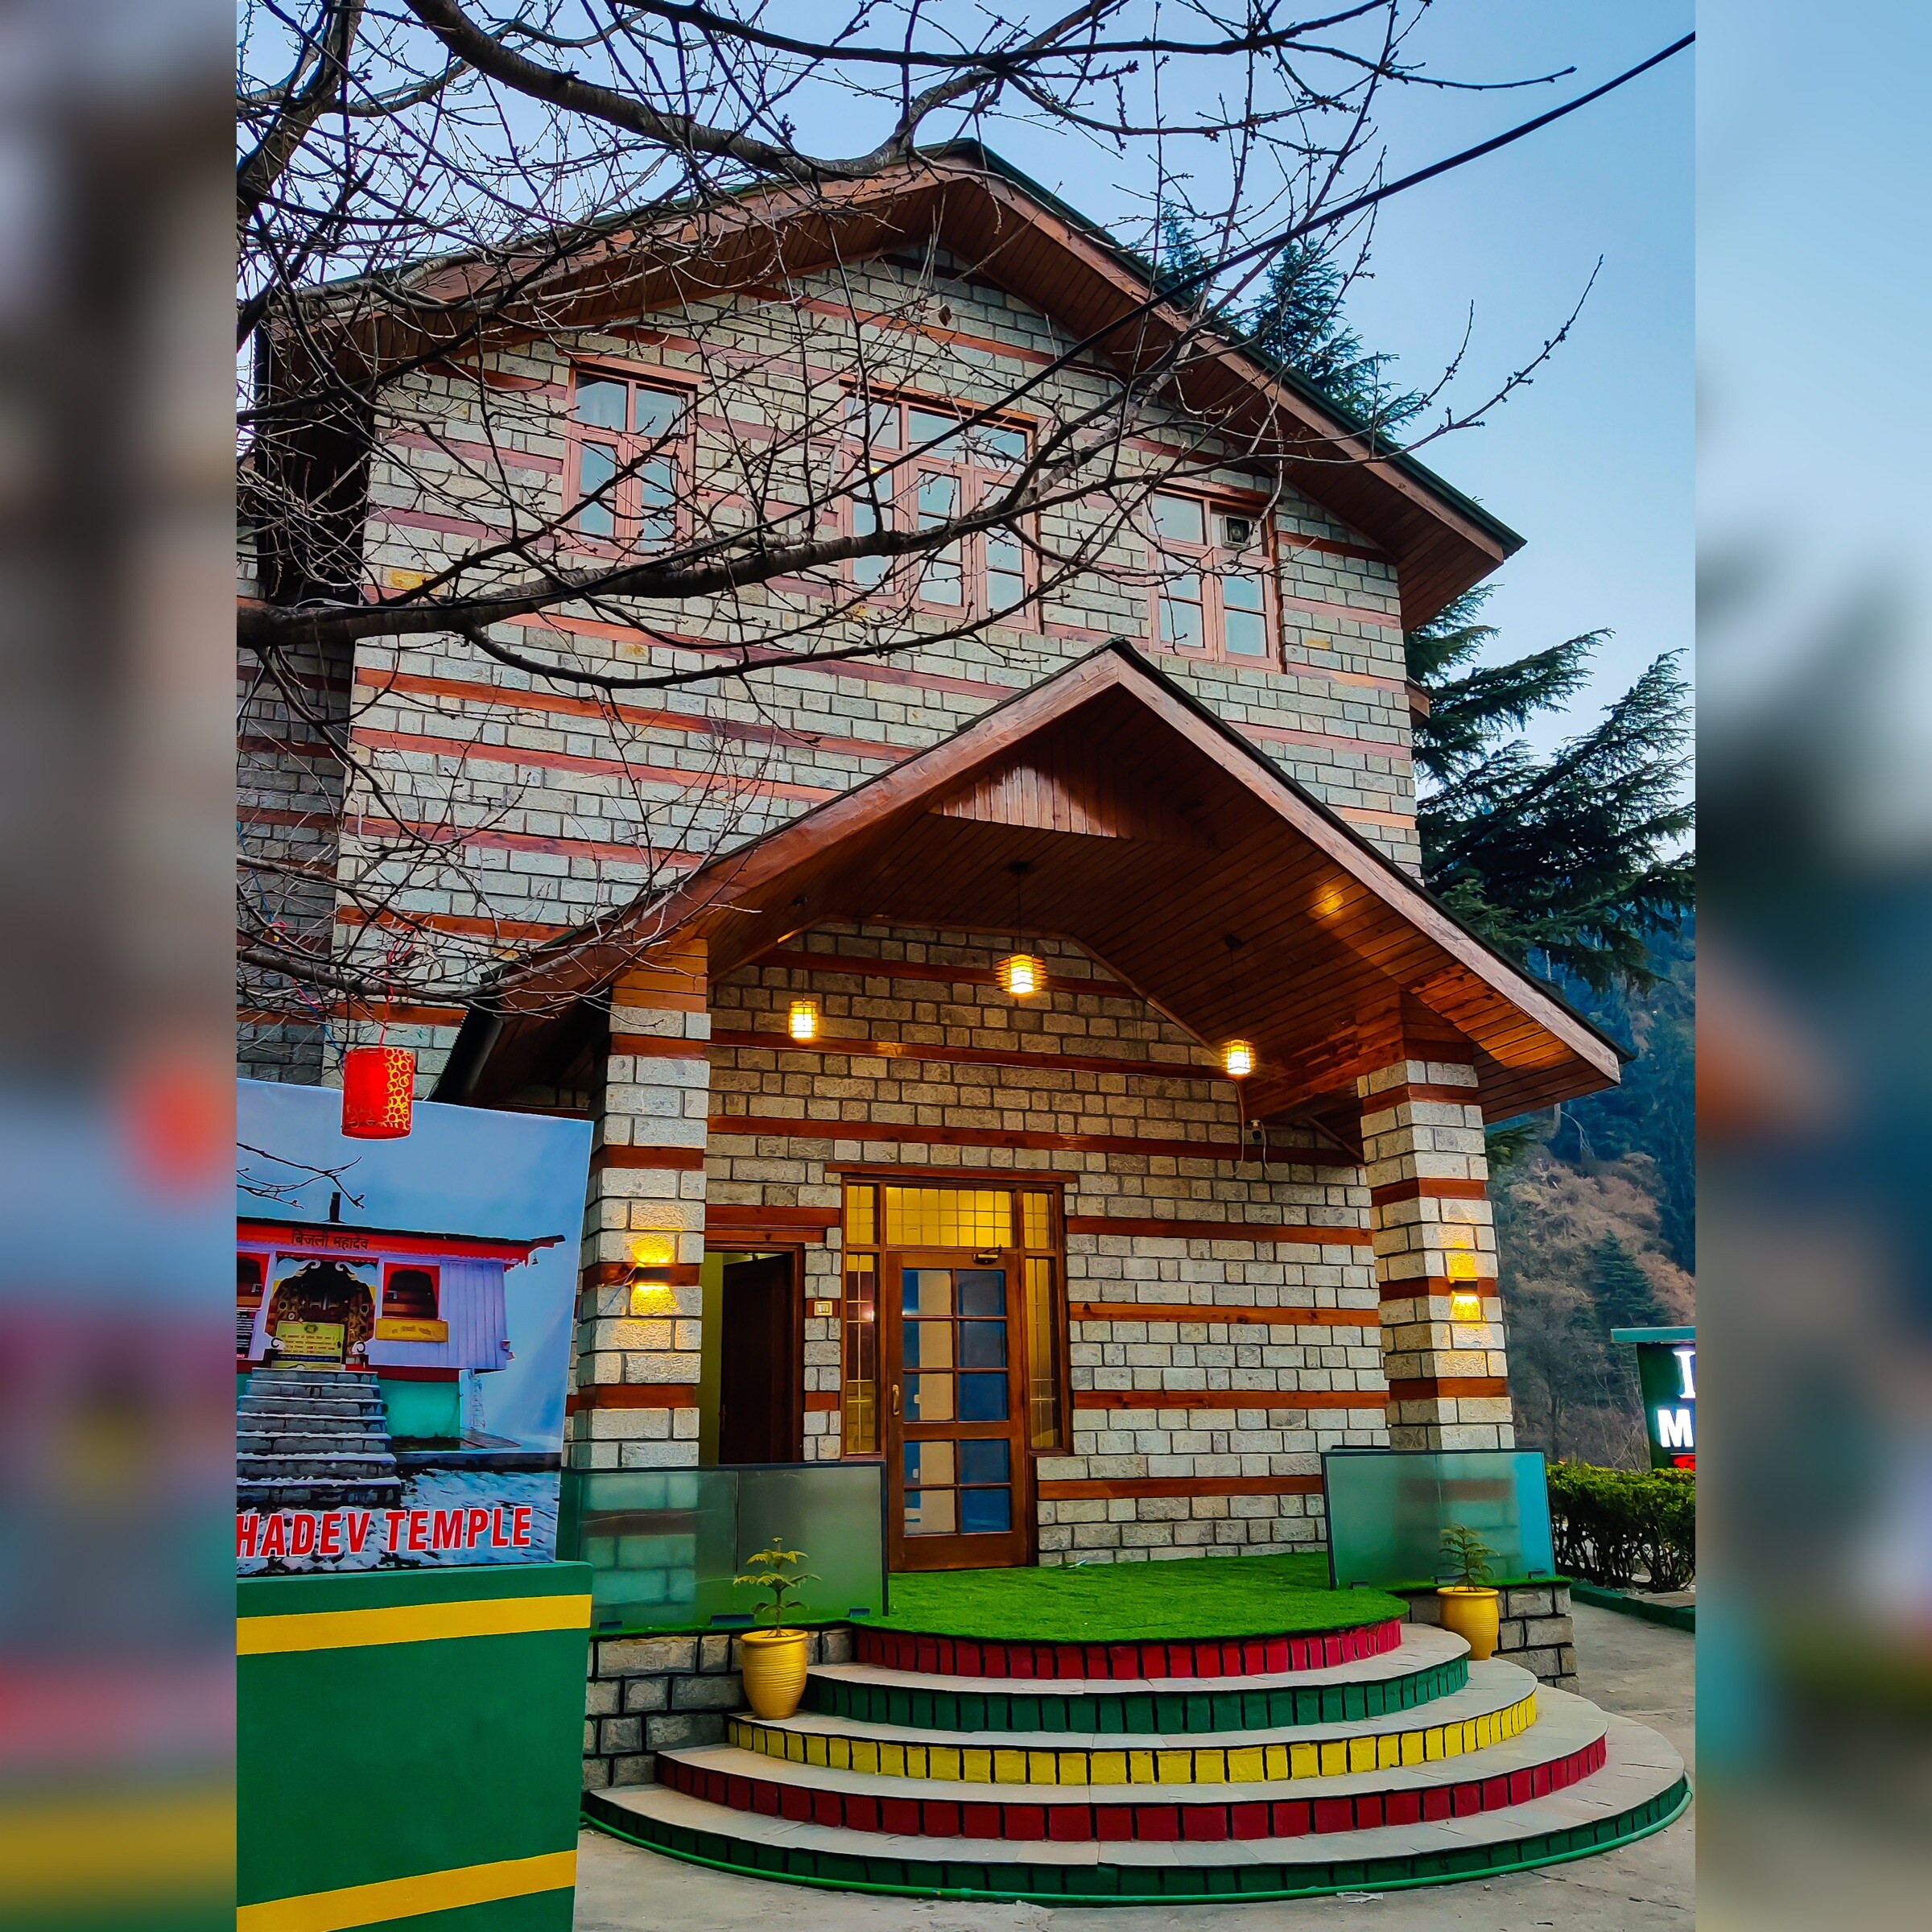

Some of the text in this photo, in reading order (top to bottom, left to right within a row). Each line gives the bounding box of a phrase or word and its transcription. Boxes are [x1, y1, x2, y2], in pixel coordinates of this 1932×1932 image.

[333, 1233, 370, 1250] महादेव
[237, 1506, 533, 1558] HADEV TEMPLE
